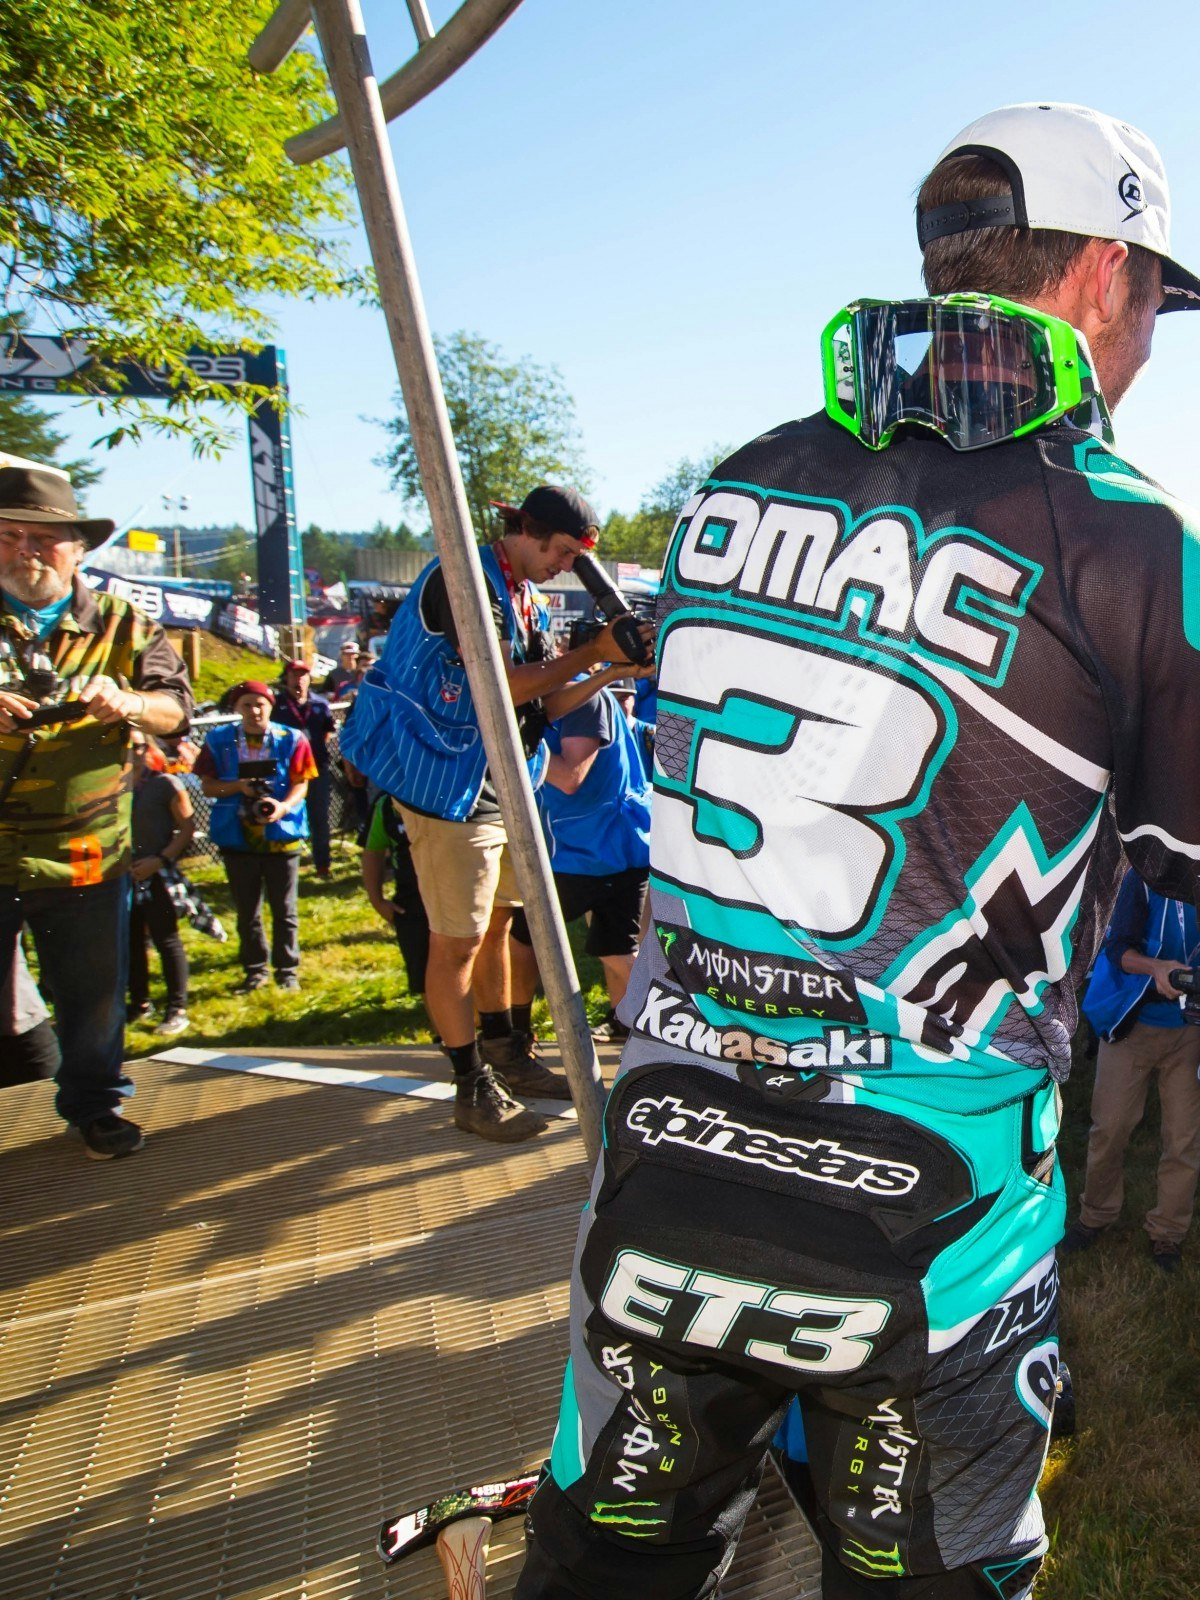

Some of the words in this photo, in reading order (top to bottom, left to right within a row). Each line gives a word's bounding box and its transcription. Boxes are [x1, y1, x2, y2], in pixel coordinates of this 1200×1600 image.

[661, 492, 1023, 667] TOMAC
[649, 626, 938, 935] 3
[635, 985, 886, 1067] Kawasaki
[707, 986, 825, 1018] ENERGY
[626, 1096, 921, 1195] alpinestars
[601, 1249, 892, 1373] ET3
